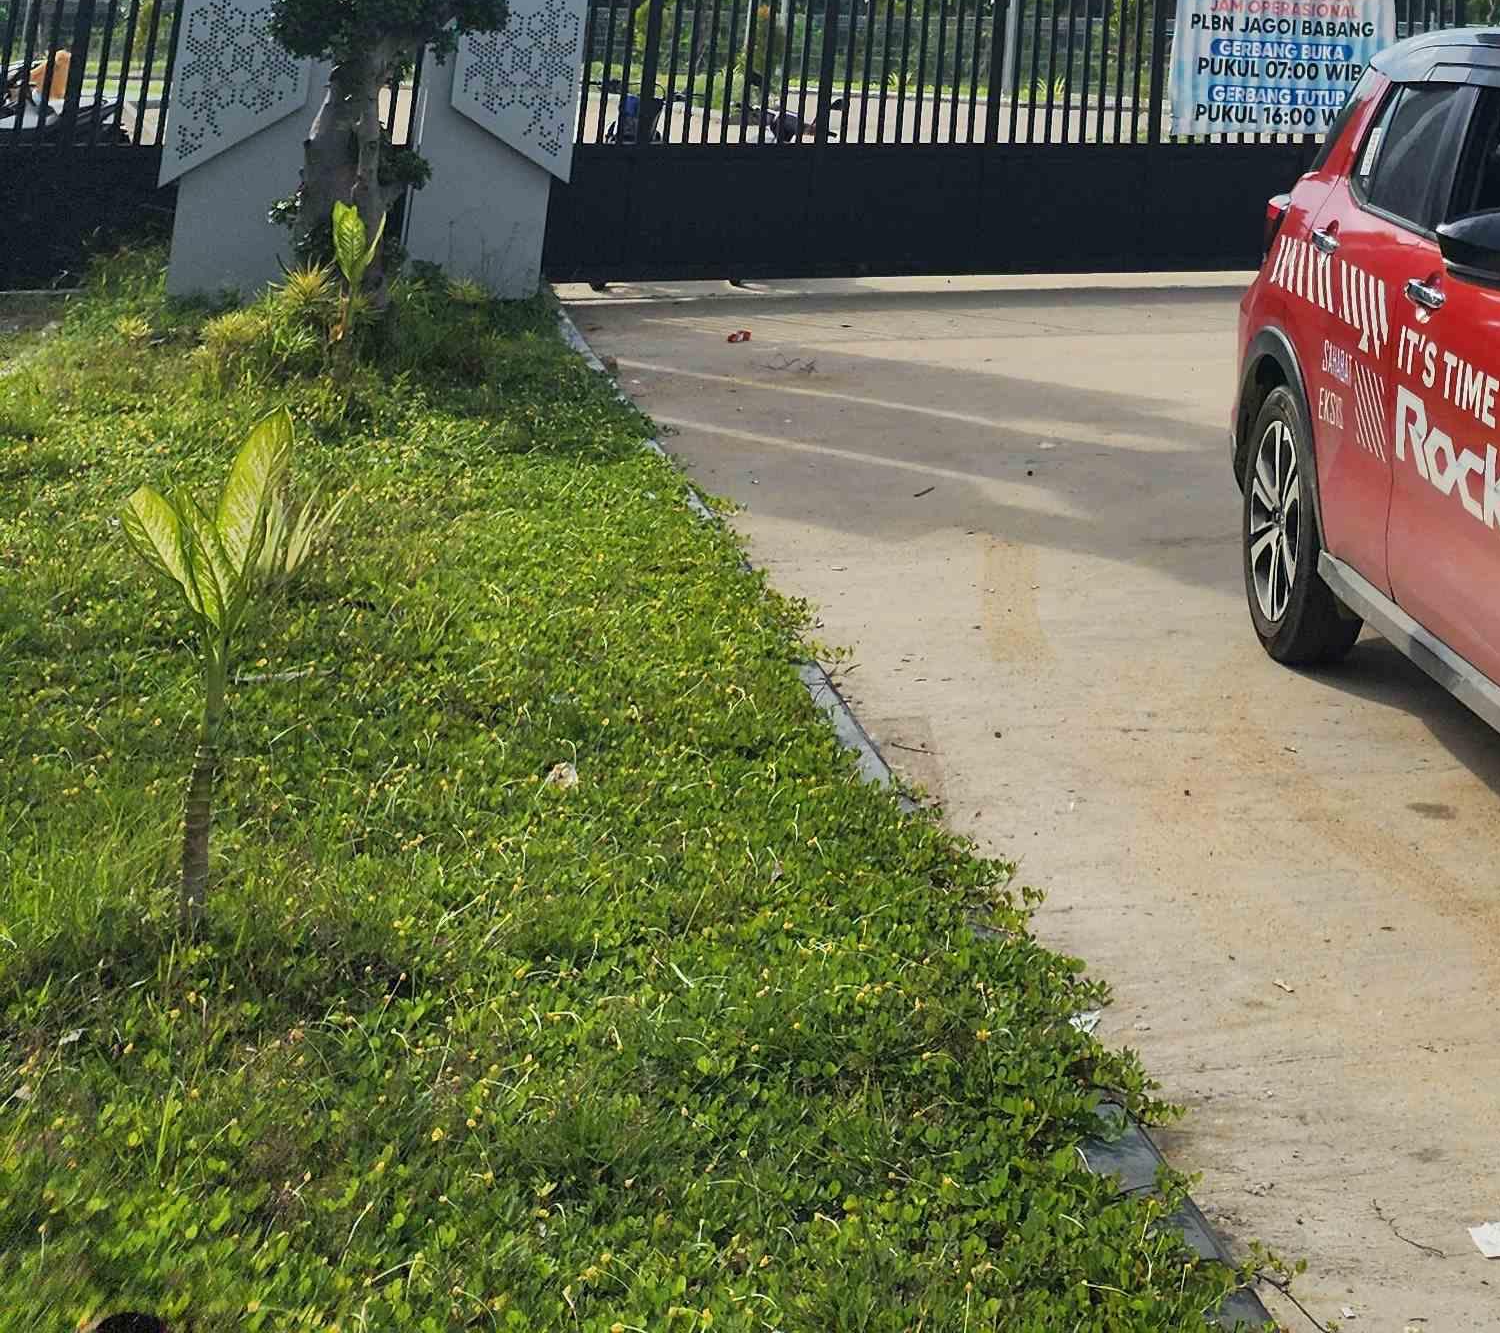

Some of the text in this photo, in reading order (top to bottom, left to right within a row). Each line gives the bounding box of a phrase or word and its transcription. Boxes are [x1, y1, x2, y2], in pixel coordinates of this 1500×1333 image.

[1247, 0, 1359, 19] OPERASIONAL
[1190, 13, 1375, 38] PLBN JAGOI BABANG
[1219, 40, 1345, 61] GERBANG BUKA
[1197, 57, 1362, 82] PUKUL 07:00 WIB
[1212, 85, 1346, 106] GERBANG TUTUP
[1195, 103, 1258, 124] PUKUL
[1262, 107, 1316, 126] 16:00
[1397, 324, 1437, 389] IT'S
[1442, 350, 1500, 430] TIME
